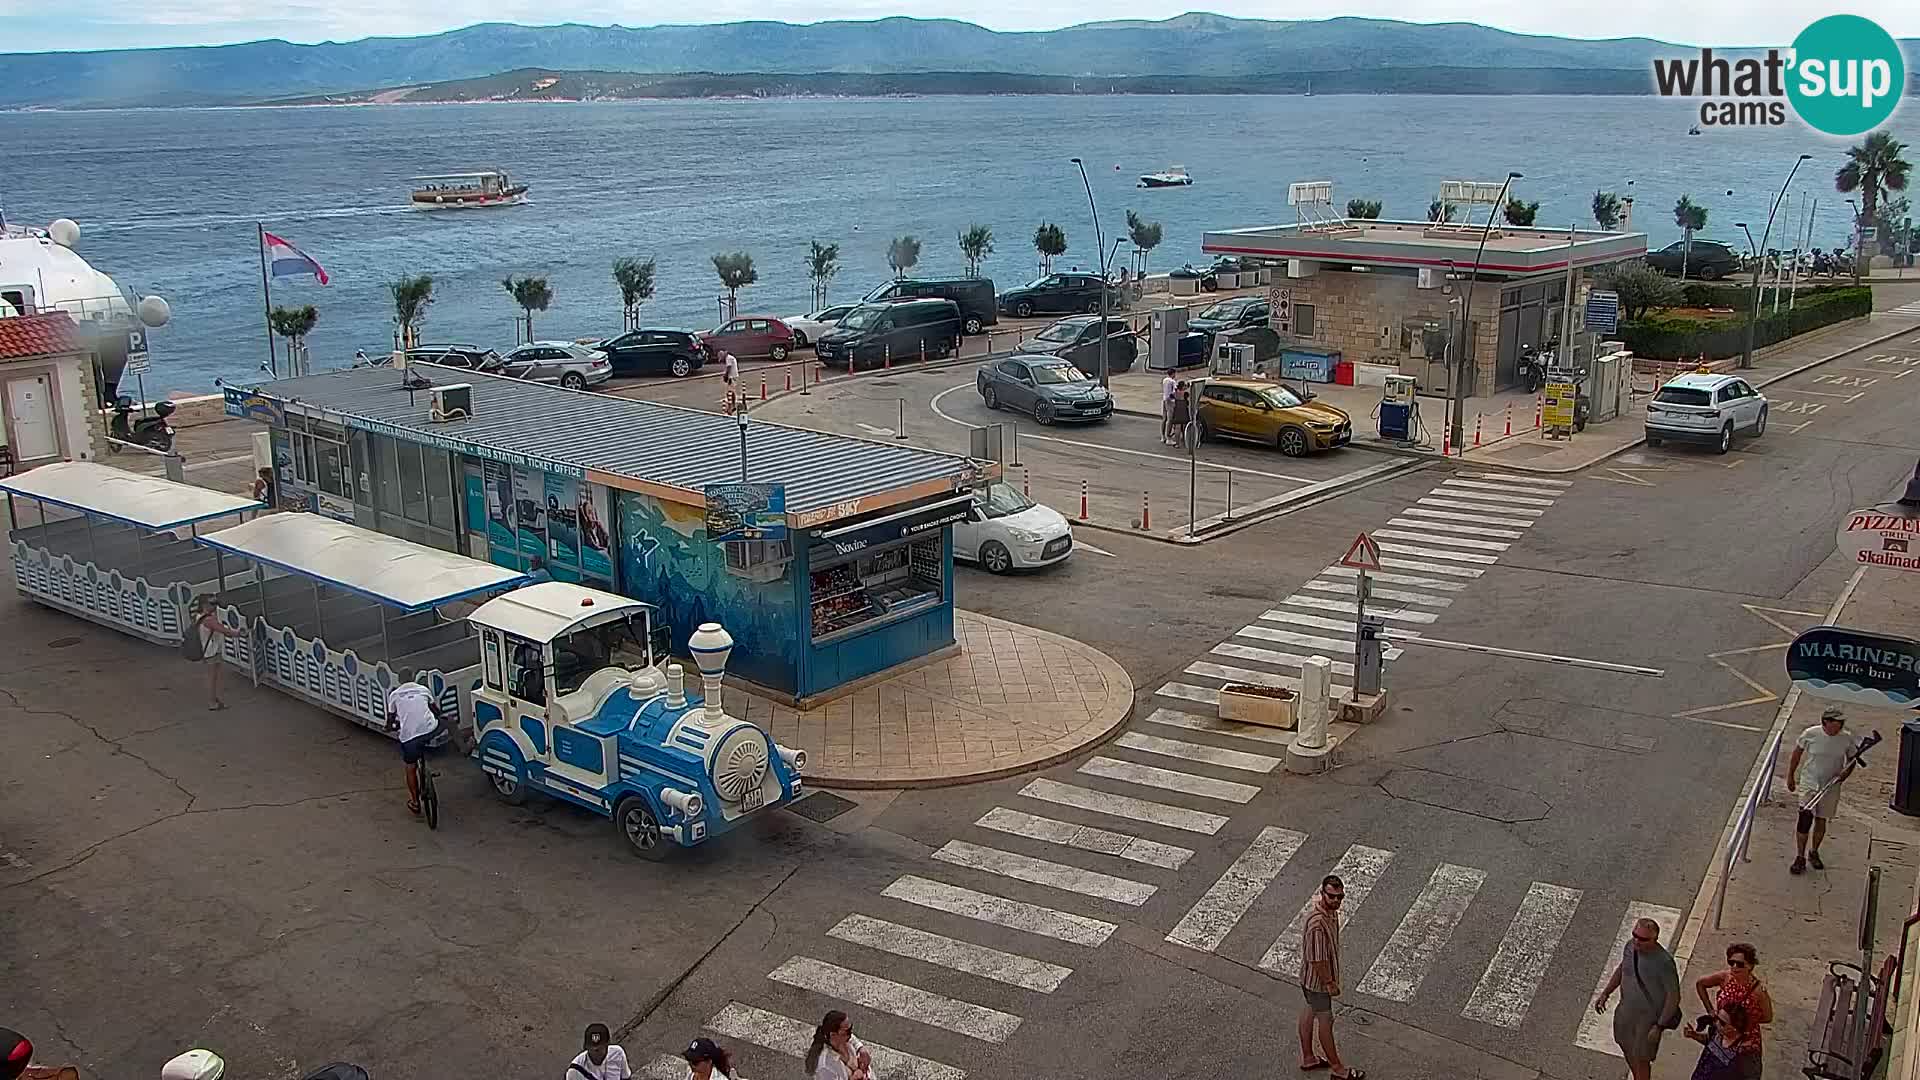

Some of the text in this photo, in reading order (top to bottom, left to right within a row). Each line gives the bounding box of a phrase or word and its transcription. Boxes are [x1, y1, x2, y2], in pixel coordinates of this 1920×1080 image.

[130, 332, 142, 350] P
[1812, 374, 1879, 387] TAXI
[435, 437, 466, 452] POSTAJA
[477, 446, 492, 458] BUS
[493, 450, 525, 465] STATION
[527, 457, 553, 471] TICKET
[554, 463, 581, 477] OFFICE
[1846, 515, 1920, 534] PIZZE
[1880, 530, 1916, 540] GRILL
[835, 539, 868, 555] Novine
[1827, 661, 1897, 680] caffe bar
